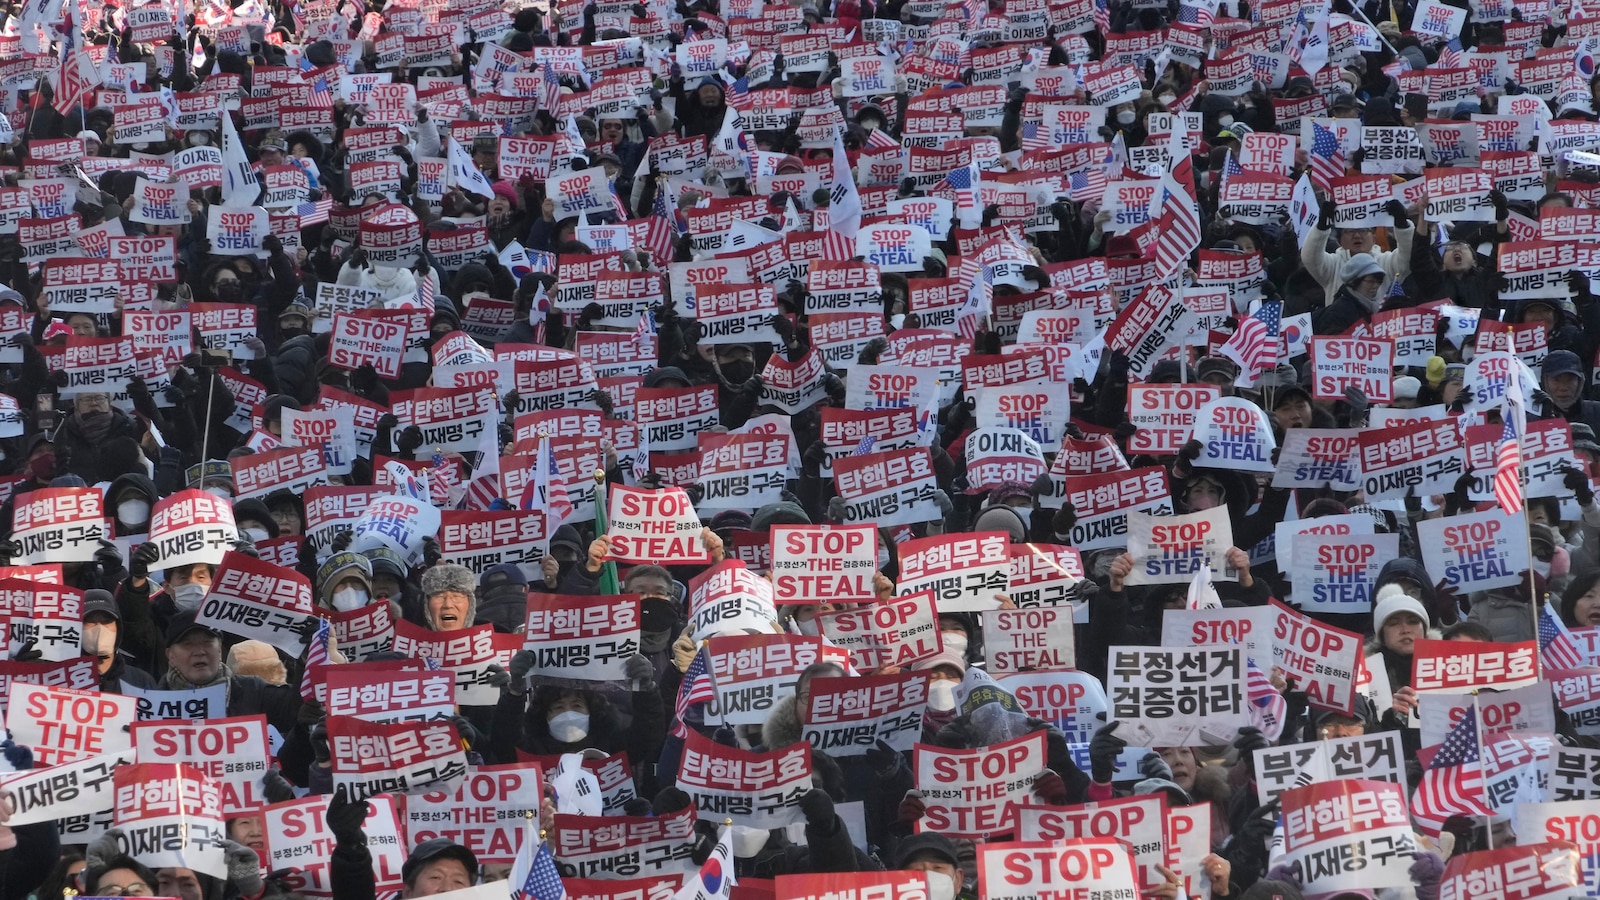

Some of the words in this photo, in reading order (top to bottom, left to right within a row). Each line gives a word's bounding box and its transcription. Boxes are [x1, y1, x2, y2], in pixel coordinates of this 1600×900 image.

[1428, 5, 1456, 18] STOP
[540, 46, 576, 58] STOP
[688, 43, 717, 56] STOP
[686, 61, 719, 73] STEAL
[852, 60, 883, 73] STOP
[1205, 56, 1256, 80] 탄핵무효
[1469, 57, 1498, 70] STOP
[512, 76, 542, 88] STOP
[851, 80, 888, 93] STEAL
[1035, 76, 1064, 90] STOP
[1085, 64, 1137, 94] 탄핵무효
[1207, 76, 1239, 94] 이재명
[372, 85, 410, 99] STOP
[378, 98, 406, 110] THE
[904, 114, 963, 134] 탄핵무효
[1057, 110, 1091, 122] STOP
[344, 129, 399, 152] 탄핵무효
[1245, 134, 1290, 150] STOP
[1428, 127, 1461, 142] STOP
[508, 141, 549, 156] STOP
[420, 161, 445, 174] STOP
[32, 183, 65, 198] STOP
[144, 185, 176, 200] STOP
[559, 174, 592, 194] STOP
[771, 179, 806, 192] STOP
[1117, 186, 1155, 201] STOP
[1226, 180, 1293, 201] 탄핵무효
[1333, 178, 1391, 206] 탄핵무효
[1426, 172, 1494, 198] 탄핵무효
[141, 206, 181, 221] STEAL
[220, 212, 256, 226] STOP
[901, 202, 938, 216] STOP
[225, 225, 251, 239] THE
[426, 229, 488, 254] 탄핵무효
[871, 228, 912, 241] STOP
[119, 239, 167, 254] STOP
[217, 237, 259, 250] STEAL
[876, 240, 907, 253] THE
[1200, 254, 1263, 281] 탄핵무효
[1501, 241, 1579, 272] 탄핵무효
[46, 260, 121, 286] 탄핵무효
[686, 266, 729, 282] STOP
[558, 283, 595, 304] 이재명
[698, 285, 776, 320] 탄핵무효
[131, 315, 183, 331] STOP
[1035, 317, 1081, 333] STOP
[1109, 282, 1174, 356] 탄핵무효
[1373, 311, 1437, 339] 탄핵무효
[144, 333, 169, 344] THE
[345, 320, 398, 342] STOP
[811, 318, 886, 343] 탄핵무효
[65, 339, 135, 368] 탄핵무효
[358, 340, 382, 354] THE
[1325, 341, 1382, 361] STOP
[1412, 338, 1435, 356] 구속
[517, 361, 597, 395] 탄핵무효
[761, 350, 824, 390] 탄핵무효
[965, 354, 1046, 388] 탄핵무효
[1318, 364, 1344, 373] 부정선거
[1343, 362, 1368, 375] THE
[868, 374, 918, 392] STOP
[415, 387, 499, 418] 탄핵무효
[641, 389, 718, 420] 탄핵무효
[876, 393, 909, 409] THE
[998, 394, 1049, 412] STOP
[1142, 389, 1211, 411] STOP
[293, 417, 337, 436] STOP
[1132, 414, 1161, 425] 부정선거
[1160, 414, 1193, 427] THE
[1212, 405, 1260, 427] STOP
[1219, 425, 1256, 444] THE
[1363, 423, 1458, 468] 탄핵무효
[702, 438, 786, 477] 탄핵무효
[1206, 440, 1267, 462] STEAL
[235, 449, 323, 493] 탄핵무효
[840, 454, 932, 498] 탄핵무효
[1294, 466, 1356, 486] STEAL
[1070, 469, 1168, 517] 탄핵무효
[13, 491, 100, 531] 탄핵무효
[369, 501, 419, 518] STOP
[67, 523, 104, 544] 구속
[444, 515, 543, 552] 탄핵무효
[611, 520, 642, 531] 부정선거
[641, 520, 675, 535] THE
[1152, 520, 1212, 543] STOP
[1443, 519, 1502, 547] STOP
[610, 537, 703, 558] STEAL
[786, 532, 865, 555] STOP
[1160, 540, 1204, 559] THE
[1318, 544, 1375, 565] STOP
[1455, 540, 1497, 565] THE
[505, 546, 544, 567] 구속
[776, 560, 807, 570] 부정선거
[807, 558, 842, 572] THE
[843, 559, 875, 570] 검증하라
[903, 536, 1006, 581] 탄핵무효
[1325, 565, 1368, 584] THE
[1445, 559, 1515, 587] STEAL
[218, 568, 314, 613] 탄핵무효
[776, 576, 871, 598] STEAL
[203, 600, 268, 629] 이재명
[527, 601, 638, 642] 탄핵무효
[836, 601, 919, 633] STOP
[997, 610, 1057, 632] STOP
[44, 624, 80, 650] 구속
[862, 628, 899, 646] THE
[899, 622, 933, 638] 검증하라
[1274, 611, 1344, 659] STOP
[393, 630, 494, 665] 탄핵무효
[594, 639, 639, 662] 구속
[710, 641, 818, 684] 탄핵무효
[994, 649, 1067, 671] STEAL
[1114, 643, 1240, 683] 부정선거
[1281, 646, 1316, 675] THE
[1315, 663, 1351, 681] 검증하라
[1416, 653, 1534, 688] 탄핵무효
[330, 677, 450, 717] 탄핵무효
[707, 683, 773, 717] 이재명
[811, 677, 926, 723] 탄핵무효
[1015, 684, 1085, 709] STOP
[1113, 683, 1242, 719] 검증하라
[26, 691, 119, 726] STOP
[36, 720, 105, 754] THE
[153, 726, 249, 757] STOP
[334, 726, 457, 772] 탄핵무효
[411, 760, 465, 788] 구속
[681, 748, 805, 790] 탄핵무효
[934, 745, 1029, 784] STOP
[6, 771, 80, 815] 이재명
[921, 789, 963, 800] 부정선거
[962, 782, 1006, 802] THE
[410, 812, 451, 822] 부정선거
[451, 808, 496, 824] THE
[1038, 806, 1145, 841] STOP
[1287, 789, 1406, 847] 탄핵무효
[120, 824, 187, 857] 이재명
[560, 811, 695, 856] 탄핵무효
[273, 845, 312, 860] 부정선거
[562, 853, 640, 879] 이재명
[1004, 848, 1113, 886] STOP
[1294, 846, 1367, 883] 이재명
[1441, 847, 1577, 900] 탄핵무효
